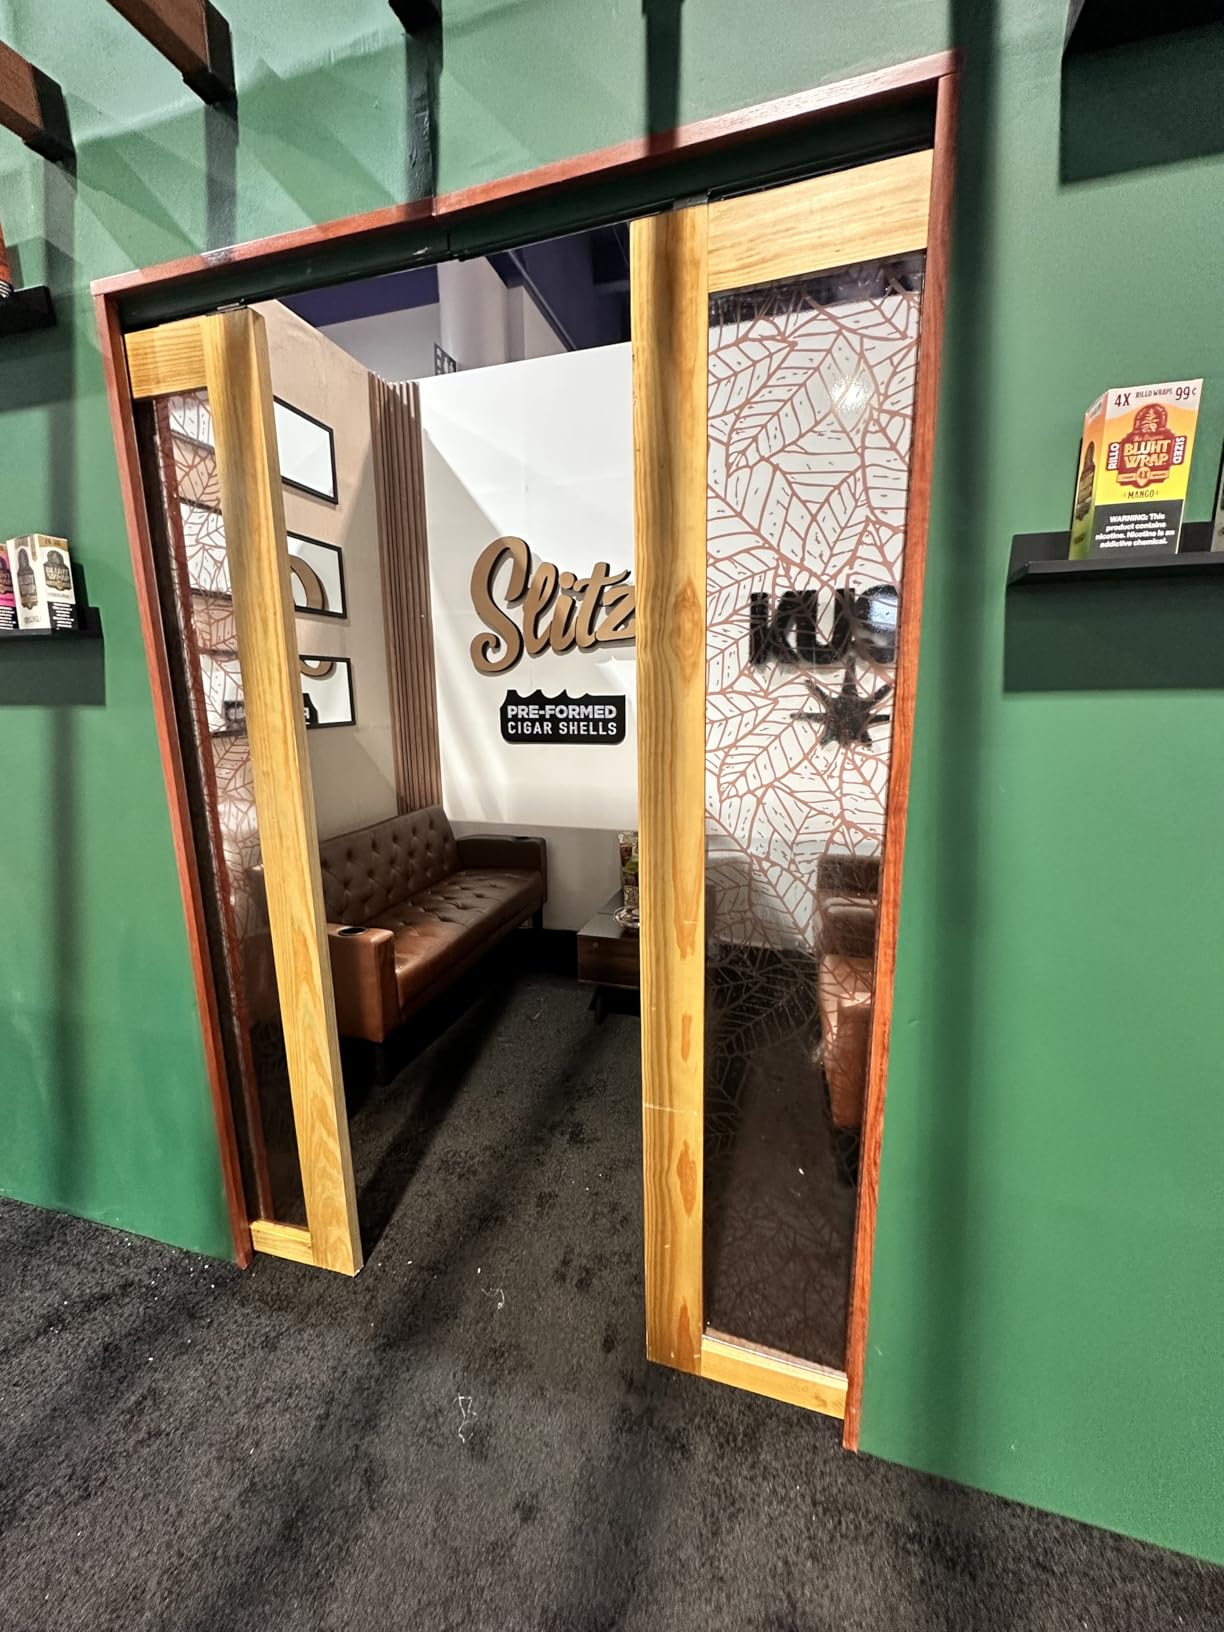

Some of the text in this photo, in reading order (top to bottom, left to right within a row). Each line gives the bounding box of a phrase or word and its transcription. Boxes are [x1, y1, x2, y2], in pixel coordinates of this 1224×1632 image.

[1114, 393, 1131, 407] 4X
[1107, 443, 1120, 470] RILLO
[1173, 436, 1185, 464] SIZED
[1124, 453, 1169, 468] WRAP
[1127, 490, 1155, 499] MANGO
[1109, 512, 1166, 523] WARNING: This
[1105, 521, 1167, 532] product contains
[1095, 532, 1126, 540] nicotine.
[1127, 530, 1157, 538] Nicotine
[1099, 537, 1168, 548] addictive chemical.
[470, 536, 636, 672] Slitz
[507, 705, 617, 719] PRE-FORMED
[508, 721, 617, 735] CIGAR SHELLS
